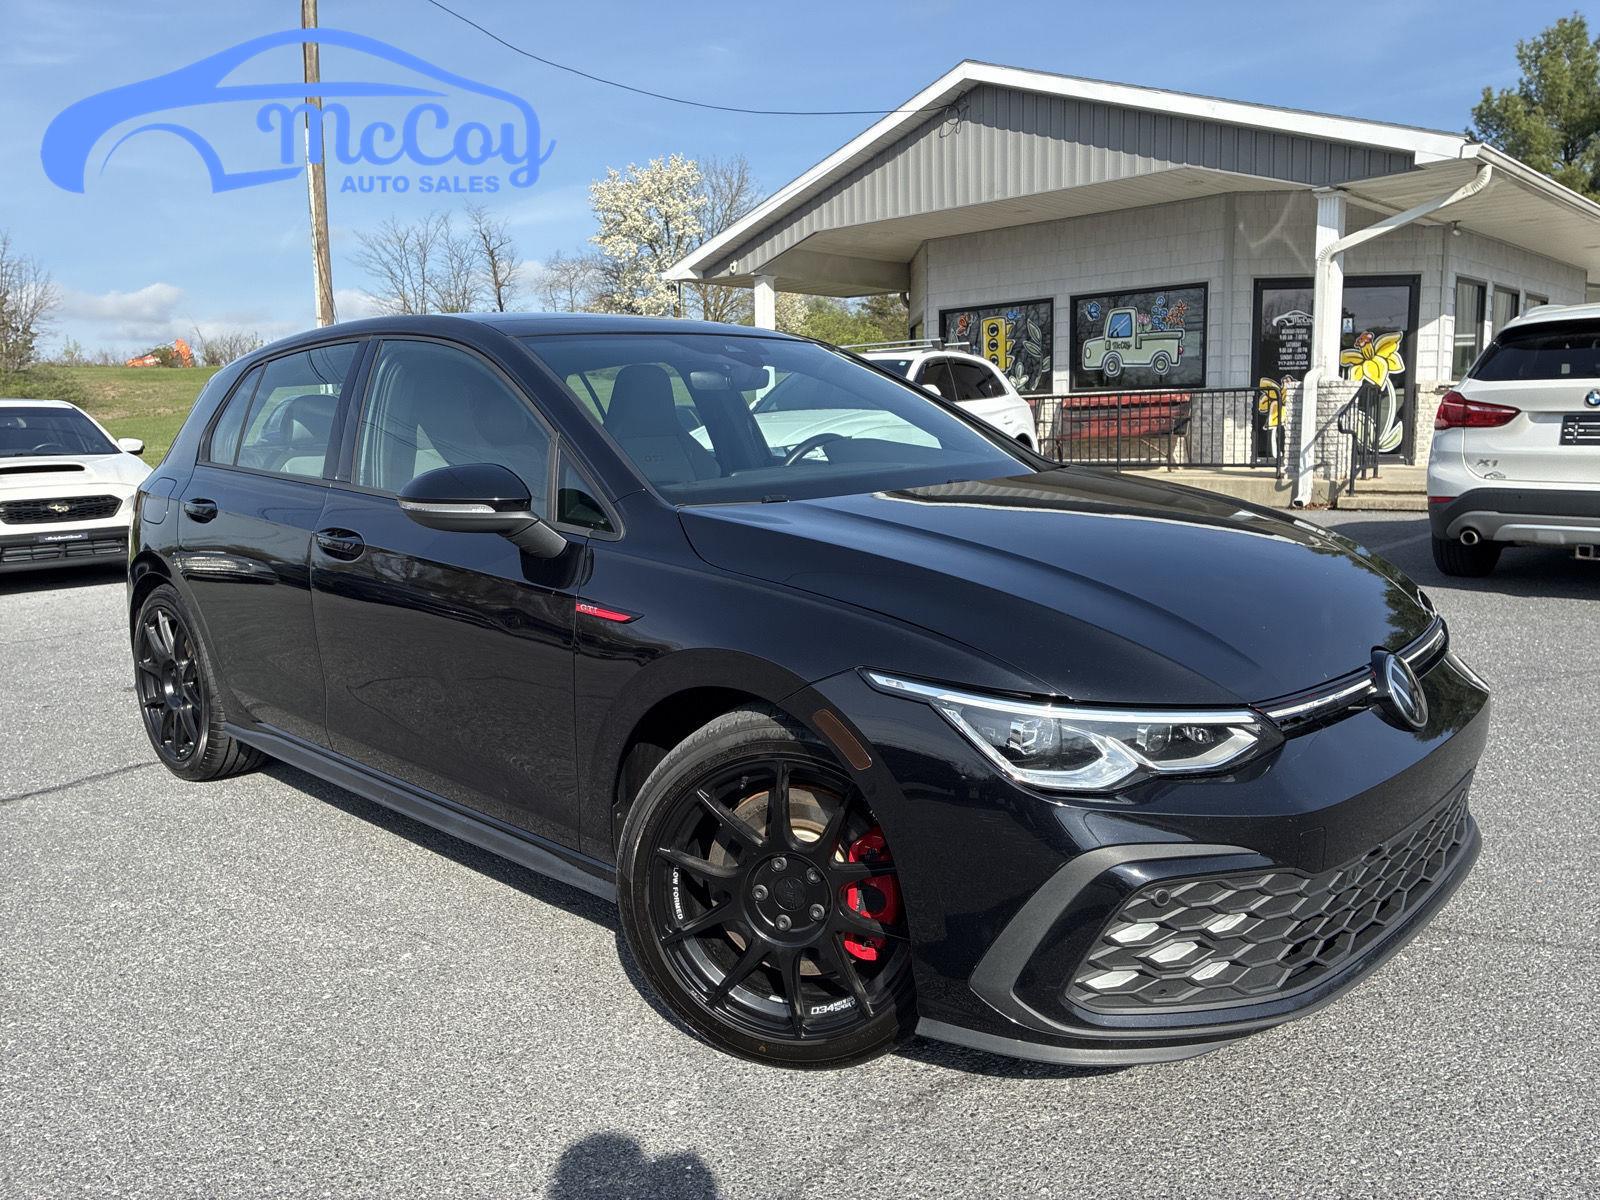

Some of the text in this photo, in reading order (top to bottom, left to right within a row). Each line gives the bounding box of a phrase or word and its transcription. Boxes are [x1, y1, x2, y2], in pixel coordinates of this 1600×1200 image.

[1477, 459, 1498, 468] X1
[580, 603, 598, 614] GTI
[672, 886, 684, 920] FORMED
